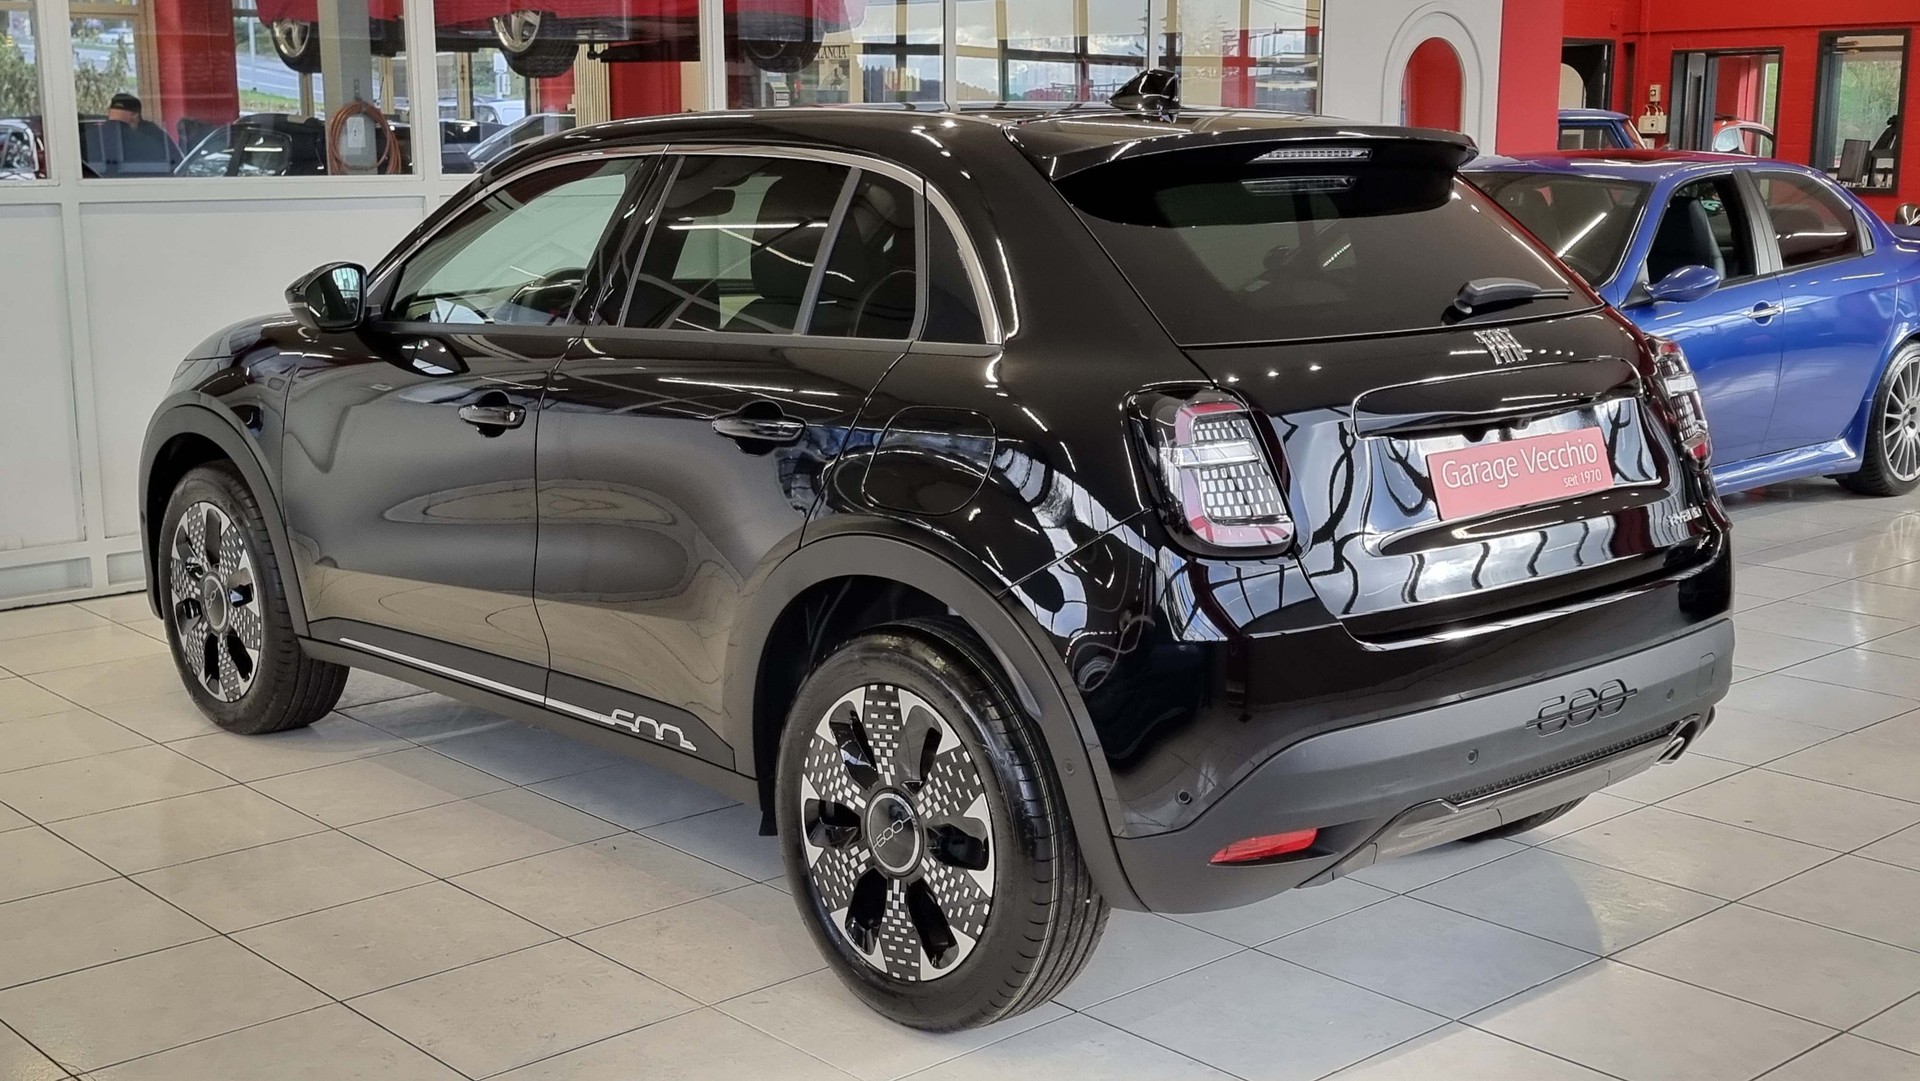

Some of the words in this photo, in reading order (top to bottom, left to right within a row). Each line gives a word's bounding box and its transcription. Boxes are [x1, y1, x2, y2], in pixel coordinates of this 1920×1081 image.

[817, 46, 847, 59] LANCIA
[1442, 456, 1519, 489] Garage
[1520, 438, 1598, 474] Vecchio
[1563, 473, 1579, 488] seit
[1580, 469, 1602, 485] 1970
[1528, 679, 1635, 737] 600
[874, 818, 907, 848] 600
